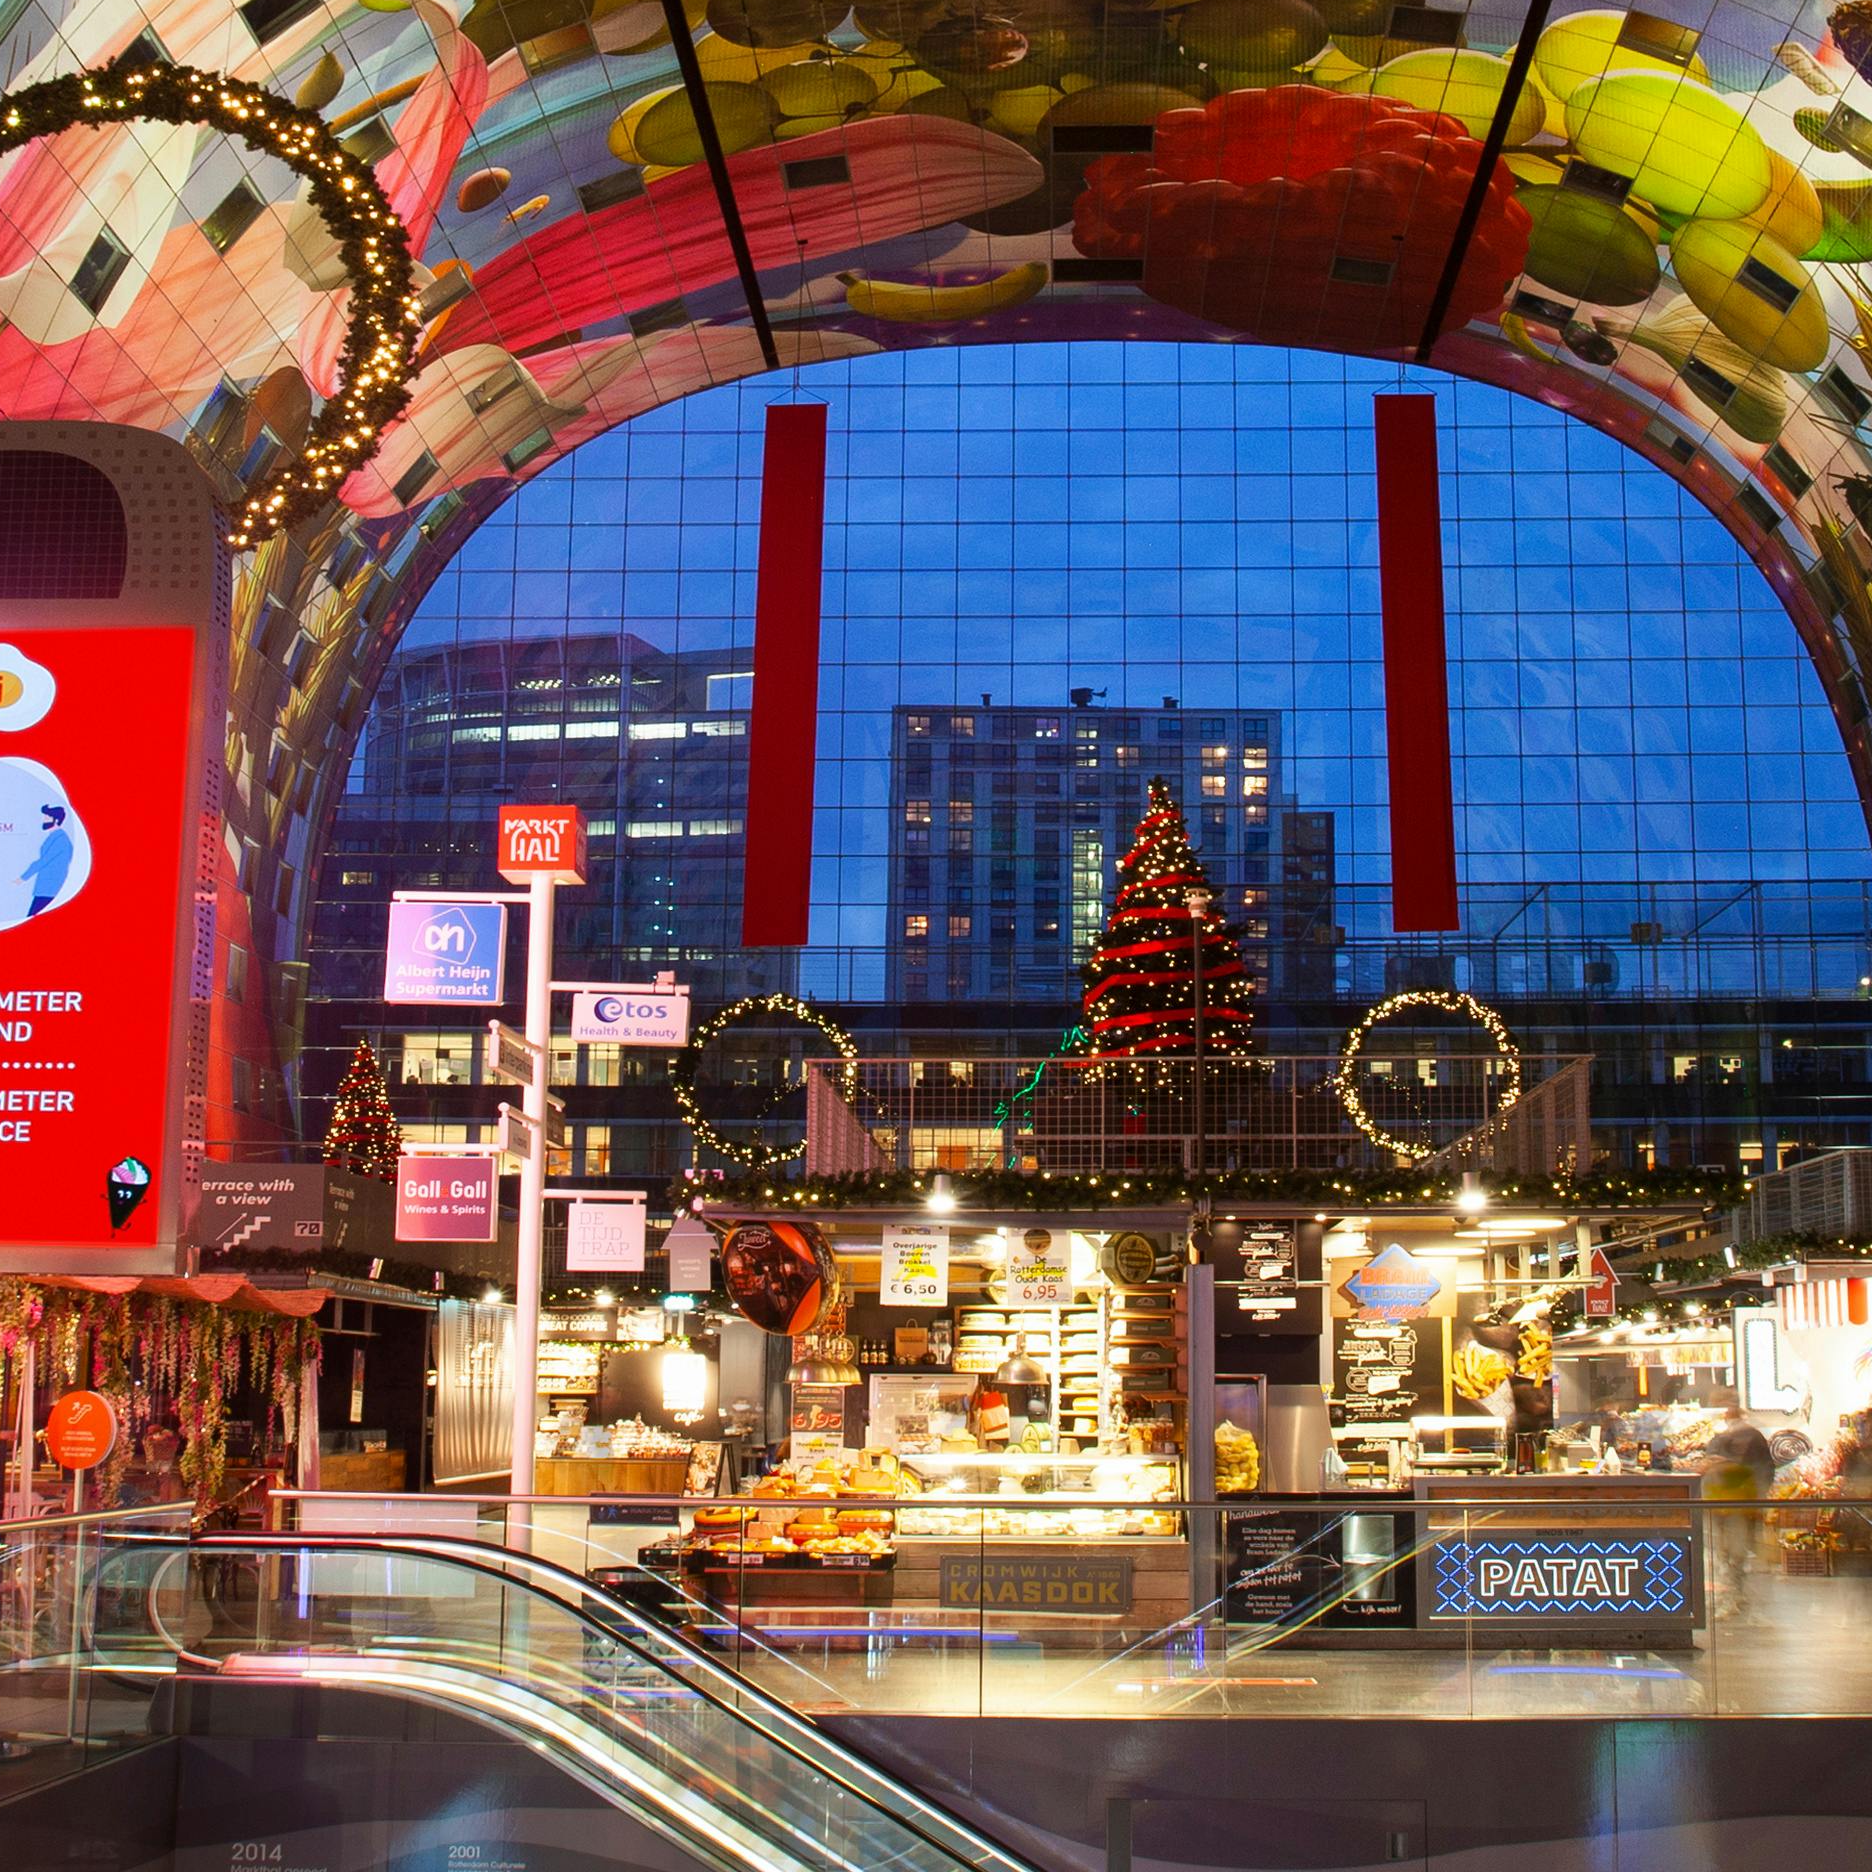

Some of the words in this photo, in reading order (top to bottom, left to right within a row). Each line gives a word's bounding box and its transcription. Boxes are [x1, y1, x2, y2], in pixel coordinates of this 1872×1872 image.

[504, 819, 570, 835] MARKT
[510, 834, 560, 862] HAL
[396, 965, 445, 978] Albert
[449, 966, 491, 981] Heijn
[395, 982, 489, 997] Supermarkt
[594, 996, 668, 1024] etos
[580, 1026, 619, 1037] Health
[623, 1027, 631, 1037] &
[636, 1027, 678, 1040] Beauty
[202, 1179, 254, 1191] errace
[259, 1178, 295, 1191] with
[404, 1180, 441, 1199] Gall
[450, 1180, 487, 1198] Gall
[215, 1195, 227, 1205] a
[232, 1193, 272, 1205] view
[404, 1205, 437, 1215] Wines
[440, 1205, 449, 1215] &
[451, 1205, 486, 1216] Spirits
[580, 1212, 604, 1225] DE
[296, 1223, 320, 1234] 70
[578, 1227, 623, 1241] TIJD
[578, 1242, 631, 1255] TRAP
[893, 1241, 937, 1250] Overjarige
[1034, 1256, 1048, 1265] De
[1010, 1264, 1068, 1275] Rotterdamse
[1015, 1274, 1039, 1284] Oude
[1042, 1274, 1064, 1284] Kaas
[904, 1284, 937, 1296] 6,50
[1023, 1284, 1058, 1302] 6,95
[569, 1321, 608, 1331] COFFEE
[950, 1564, 1079, 1577] CROMWIJK
[1480, 1558, 1638, 1596] PATAT
[950, 1580, 1121, 1604] KAASDOK
[231, 1842, 282, 1861] 2014
[448, 1845, 481, 1858] 2001
